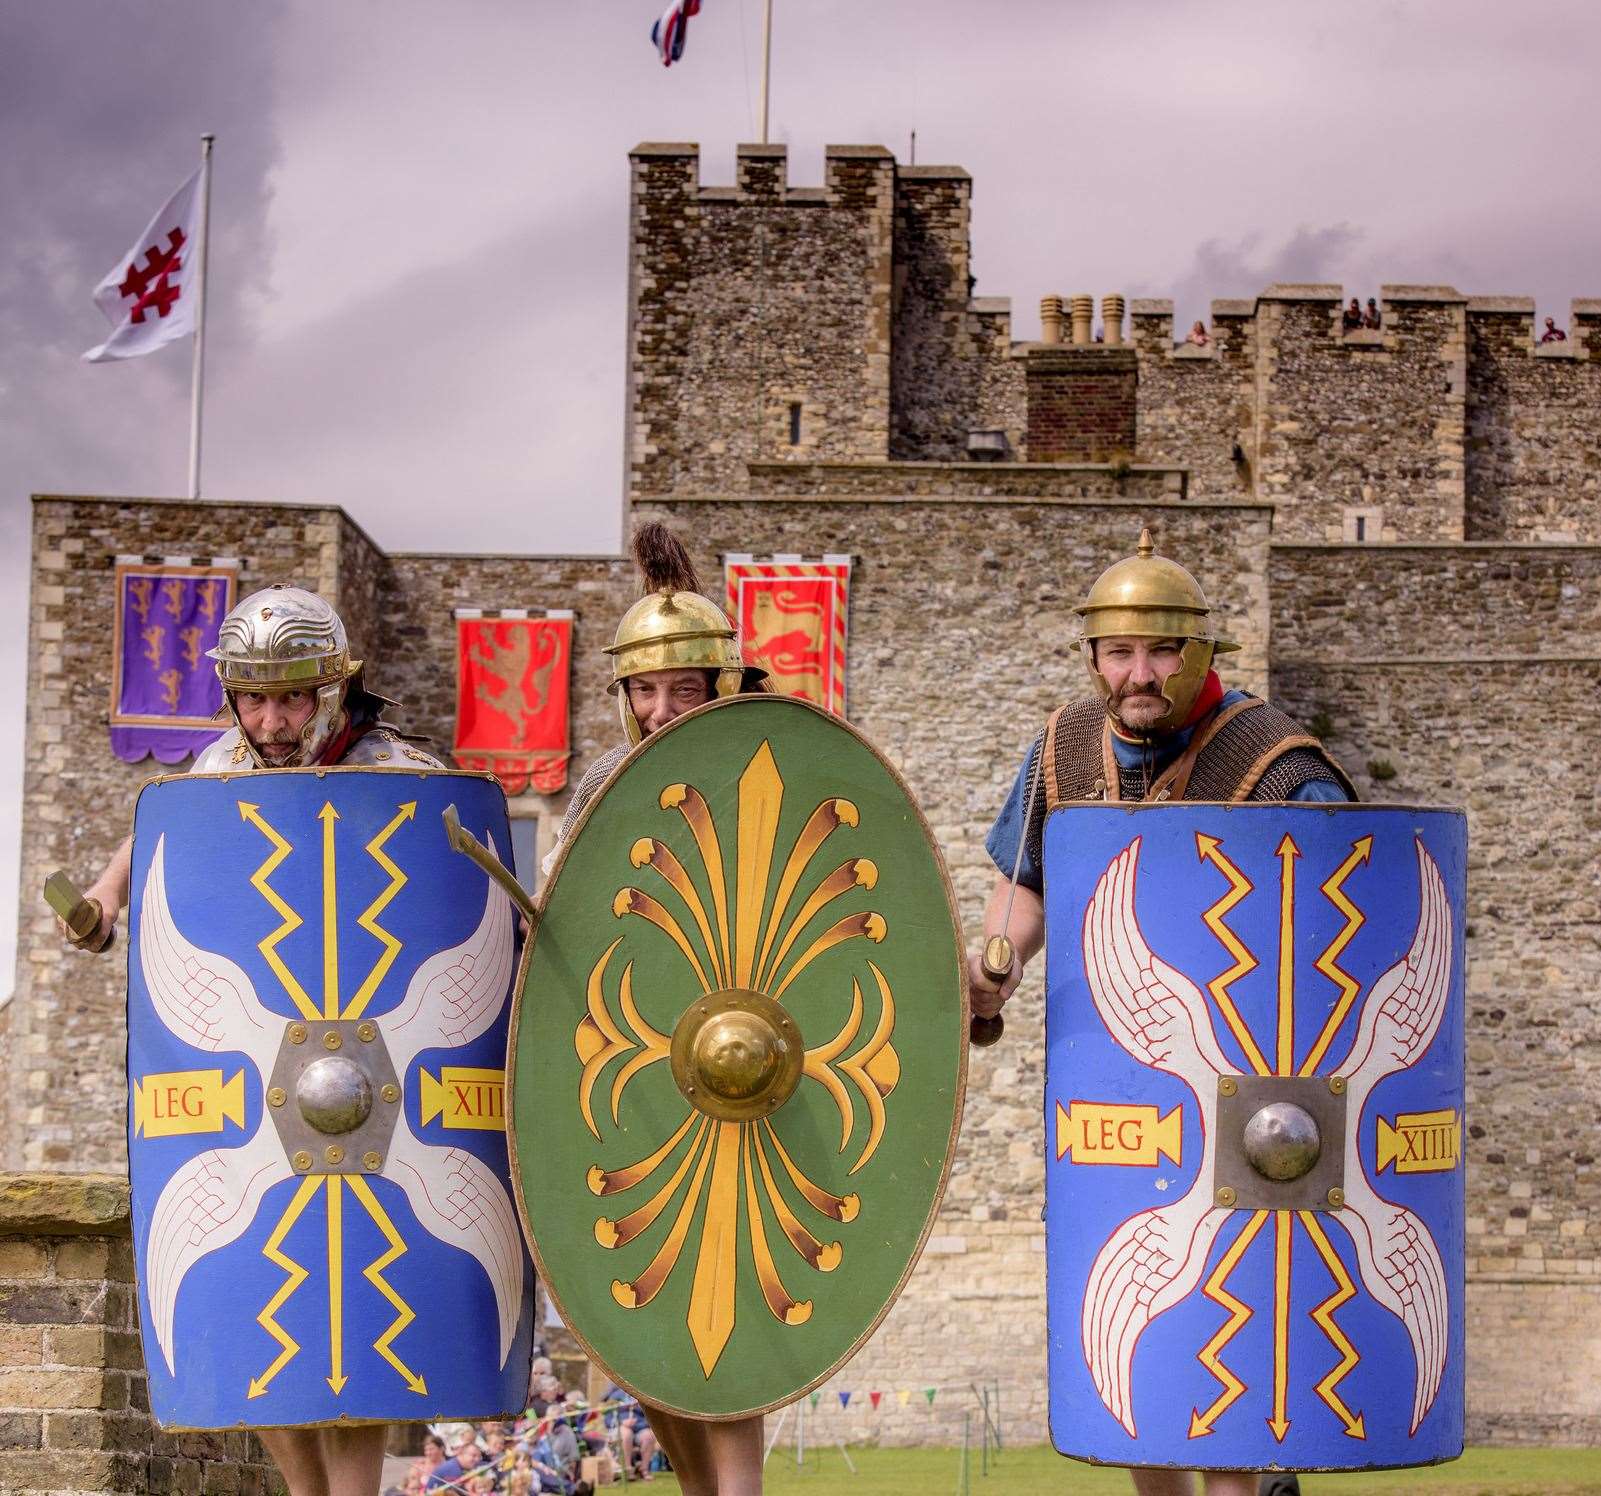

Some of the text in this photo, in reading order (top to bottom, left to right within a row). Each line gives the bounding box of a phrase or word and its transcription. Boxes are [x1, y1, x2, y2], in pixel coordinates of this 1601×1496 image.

[154, 1086, 205, 1118] LEG
[1082, 1118, 1453, 1162] LEG XIIII
